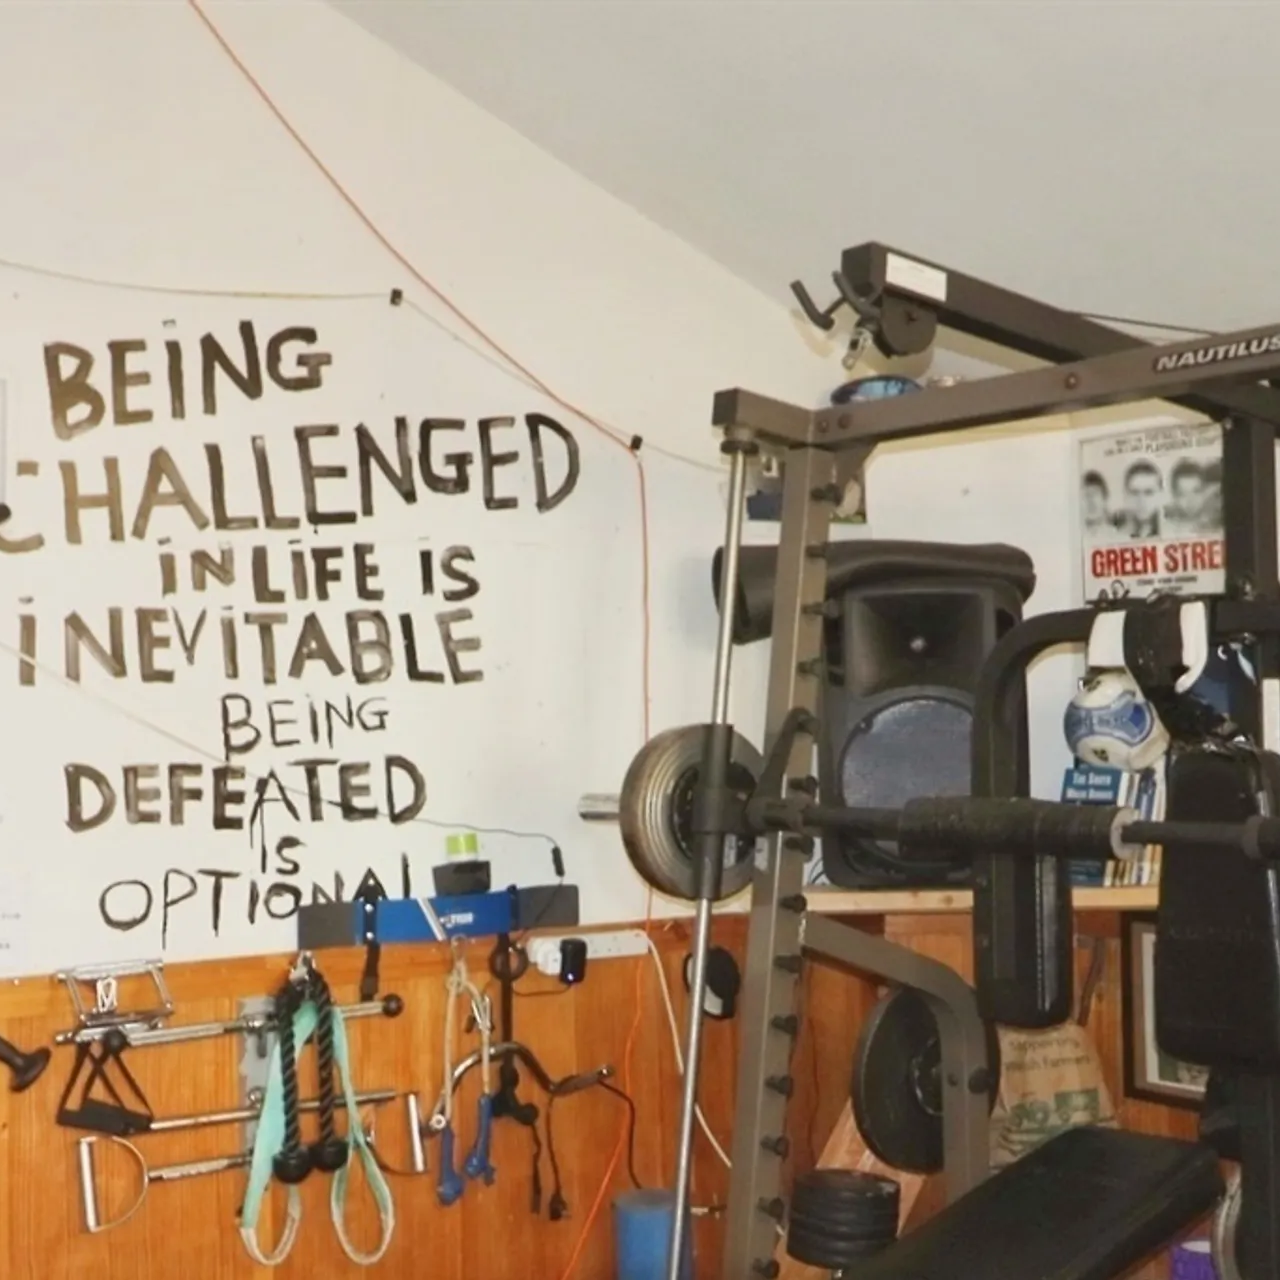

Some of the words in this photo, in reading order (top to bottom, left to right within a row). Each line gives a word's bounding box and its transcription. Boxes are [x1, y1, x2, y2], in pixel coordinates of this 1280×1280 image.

[44, 318, 333, 441] BEING
[158, 537, 235, 598] IN
[251, 539, 385, 603] LIFE
[418, 540, 481, 602] IS
[1091, 545, 1160, 579] GREEN
[1163, 540, 1228, 575] STRE
[18, 596, 485, 687] INEVITABLE
[220, 693, 391, 763] BEING
[63, 754, 427, 833] DEFEATED
[258, 833, 306, 875] IS
